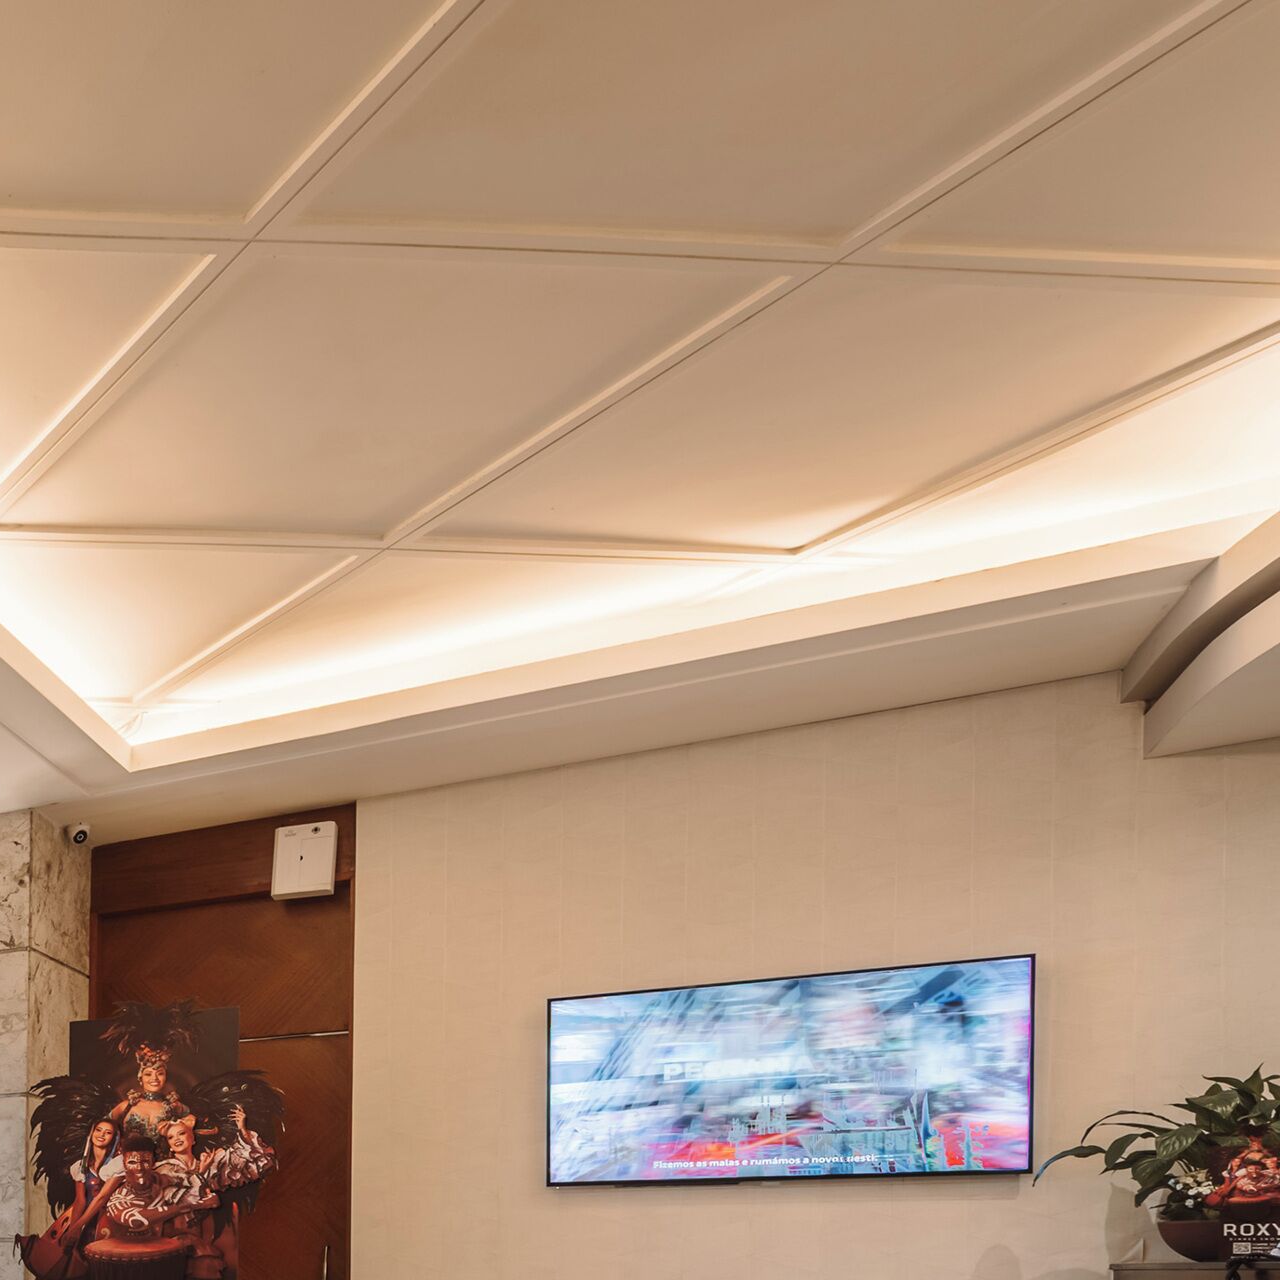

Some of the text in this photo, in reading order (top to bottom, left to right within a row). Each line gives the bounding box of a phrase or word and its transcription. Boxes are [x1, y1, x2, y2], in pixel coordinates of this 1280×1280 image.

[653, 1160, 694, 1169] Fizemos
[708, 1158, 739, 1168] malas
[750, 1156, 801, 1166] rumámos
[1223, 1223, 1280, 1236] ROXY
